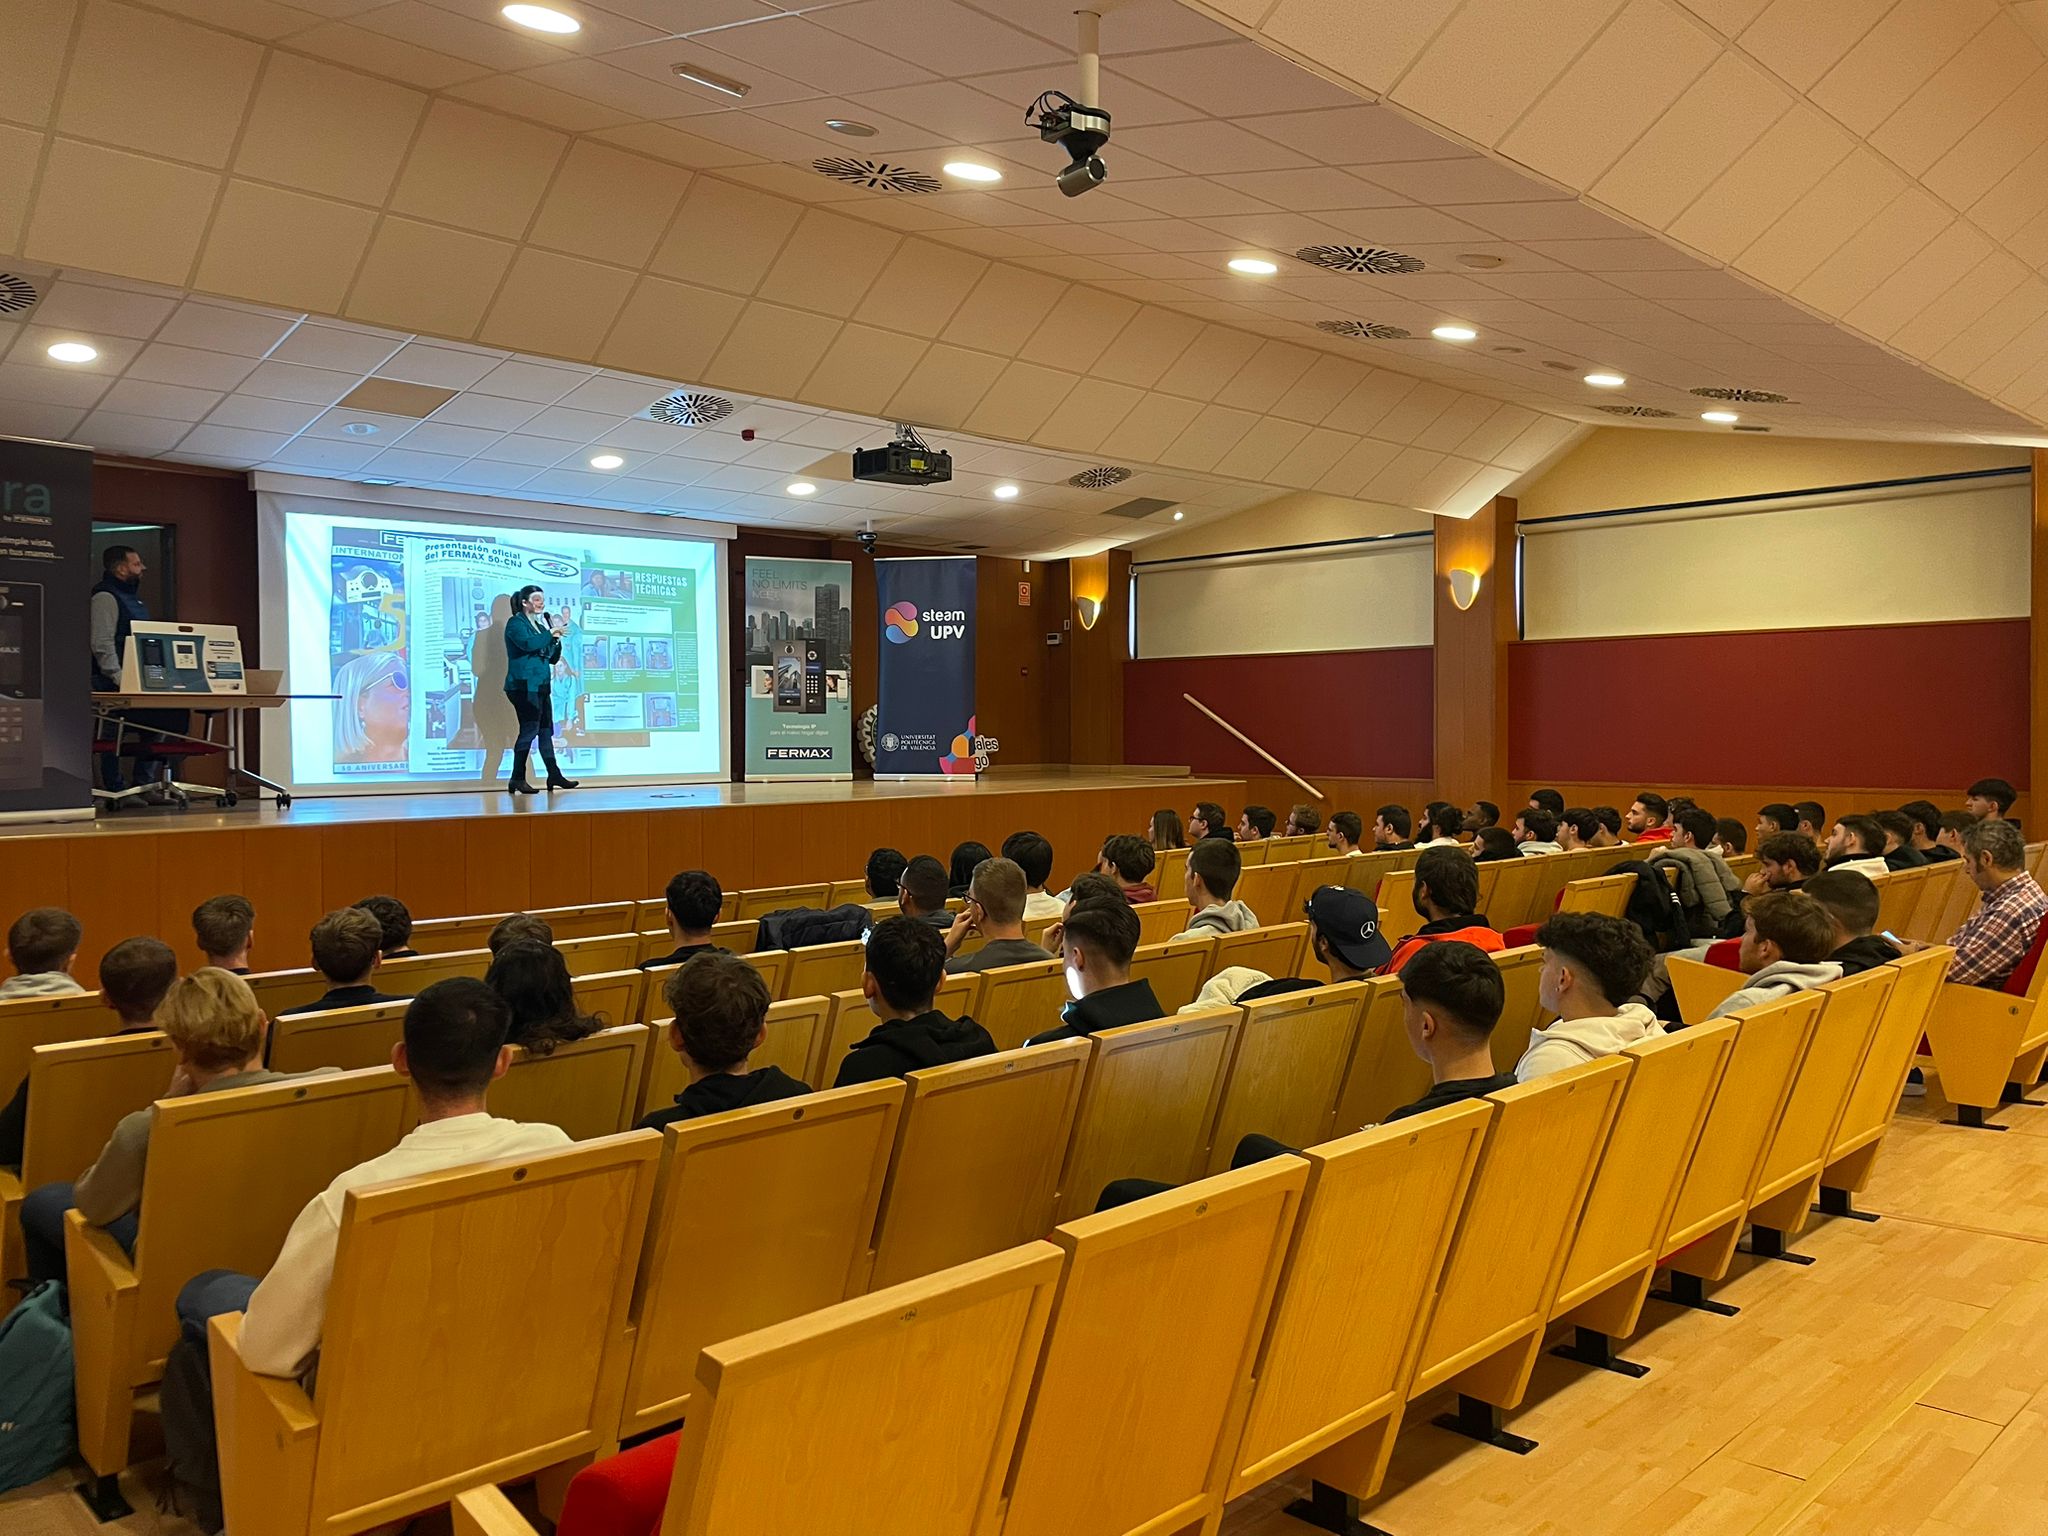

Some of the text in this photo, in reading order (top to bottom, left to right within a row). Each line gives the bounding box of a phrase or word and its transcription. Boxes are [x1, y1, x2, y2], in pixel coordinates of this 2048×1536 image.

[4, 481, 51, 514] ra
[425, 551, 438, 560] del
[442, 550, 485, 561] FERMAX
[488, 555, 522, 568] 50-CNJ
[492, 548, 521, 560] oficial
[634, 572, 688, 587] RESPUESTAS
[752, 568, 779, 579] FEEL
[752, 579, 808, 591] NO LIMITS
[922, 608, 966, 622] steam
[930, 624, 966, 640] UPV
[767, 748, 831, 758] FERMAX
